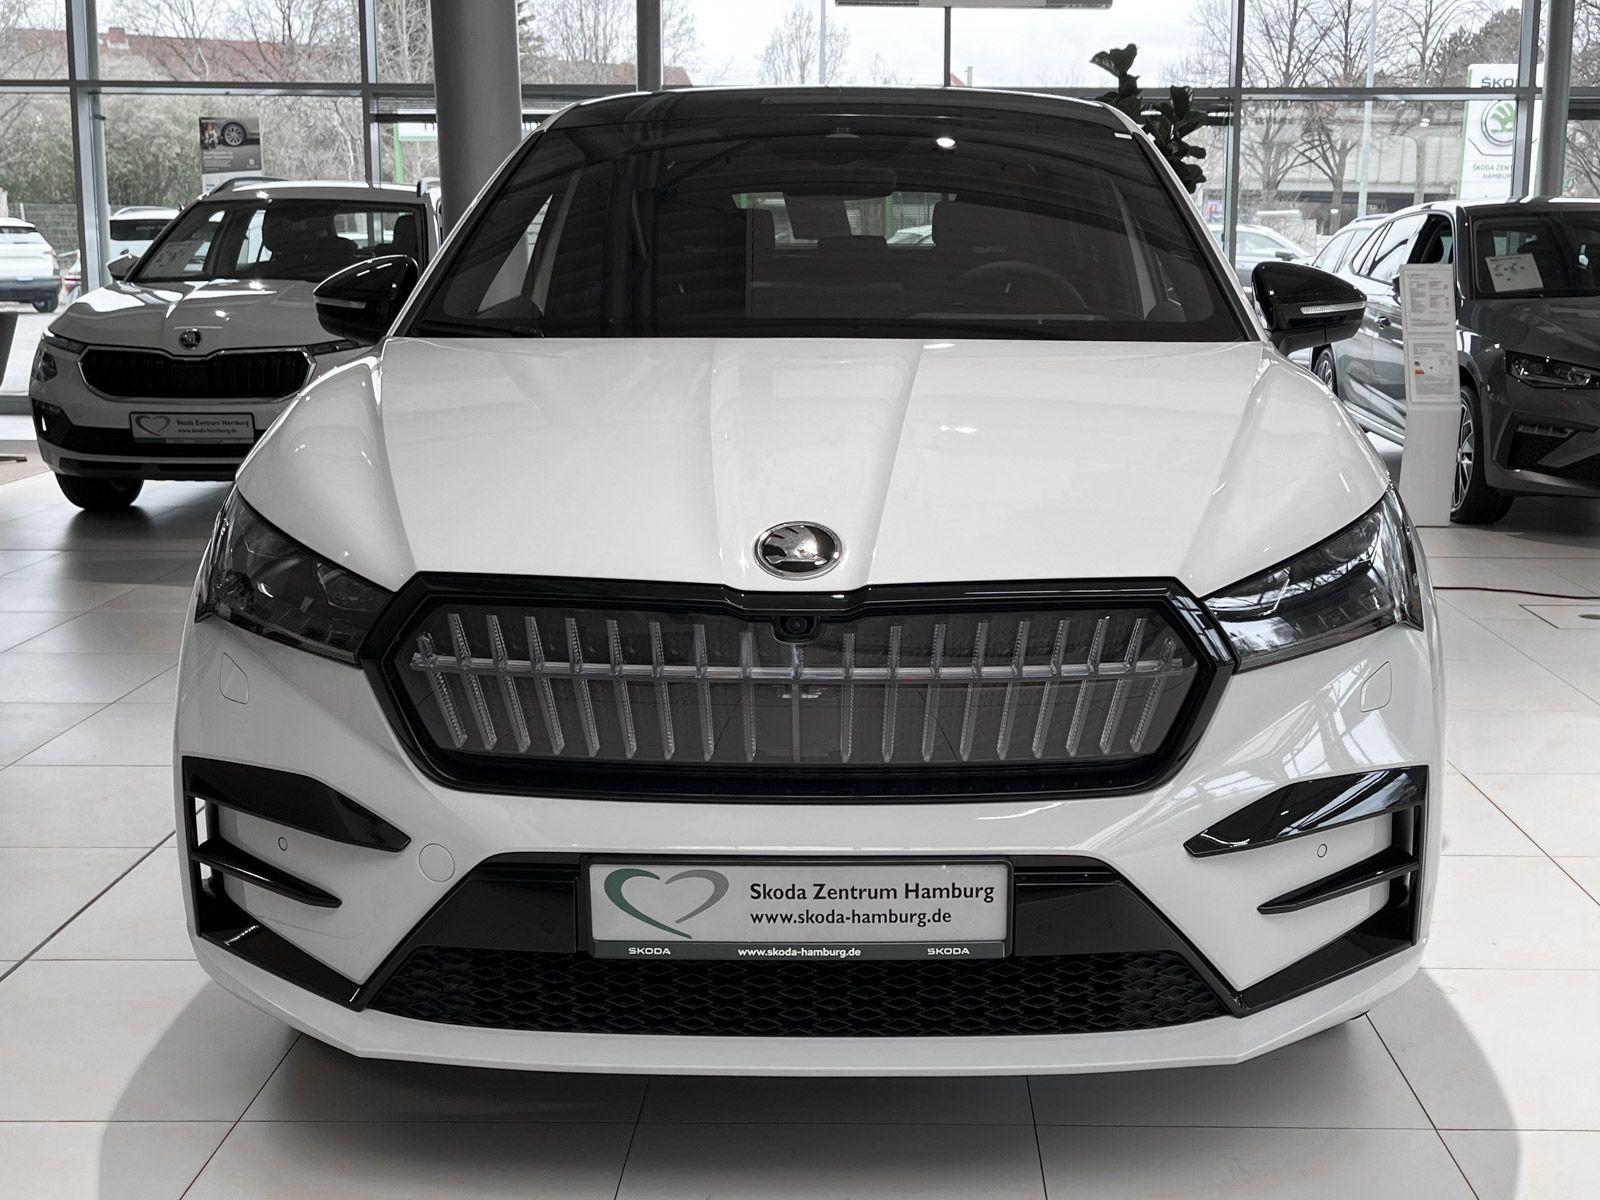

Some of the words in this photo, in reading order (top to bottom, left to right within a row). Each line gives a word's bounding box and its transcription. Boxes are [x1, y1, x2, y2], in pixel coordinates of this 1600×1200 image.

[1481, 76, 1518, 88] ŠKO
[750, 883, 807, 900] Skoda
[812, 883, 898, 900] Zentrum
[904, 882, 995, 903] Hamburg
[750, 908, 952, 928] www.skoda-hamburg.de
[628, 947, 671, 955] SKODA
[737, 947, 861, 958] www.skoda-hamburg.de
[927, 947, 970, 955] SKODA
